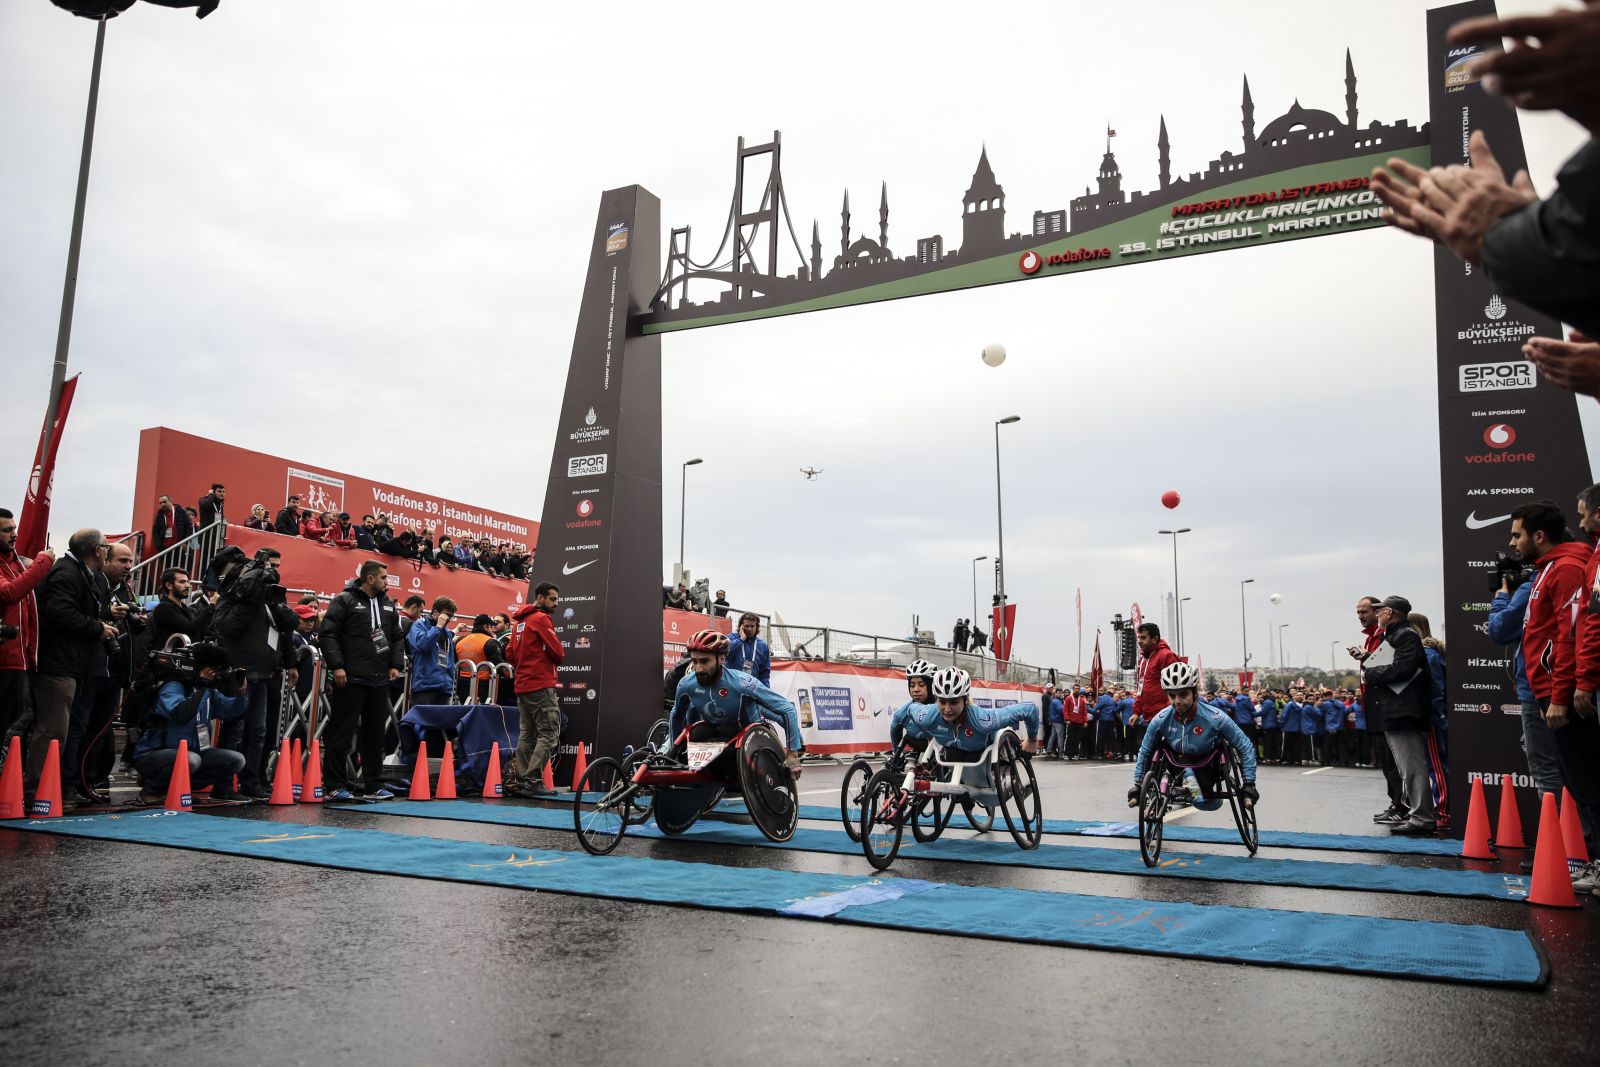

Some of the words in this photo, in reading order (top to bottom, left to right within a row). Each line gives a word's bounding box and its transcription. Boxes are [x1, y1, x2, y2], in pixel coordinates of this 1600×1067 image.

[1447, 45, 1477, 57] IAAF
[1448, 74, 1470, 84] GOLD
[1448, 85, 1466, 93] Label
[1462, 106, 1470, 158] MARATONU
[1045, 247, 1111, 266] vodafone
[1457, 323, 1536, 340] BÜYÜKŞEHİR
[1464, 364, 1531, 380] SPOR
[1488, 408, 1526, 416] SPONSORU
[570, 456, 604, 469] SPOR
[1464, 451, 1537, 464] vodafone
[1466, 488, 1488, 496] ANA
[1490, 487, 1534, 495] SPONSOR
[372, 487, 424, 511] Vodafone
[425, 500, 441, 516] 39.
[442, 501, 483, 525] İstanbul
[484, 515, 528, 536] Maratonu
[566, 519, 602, 529] vodafone
[1467, 657, 1511, 667] HİZMET
